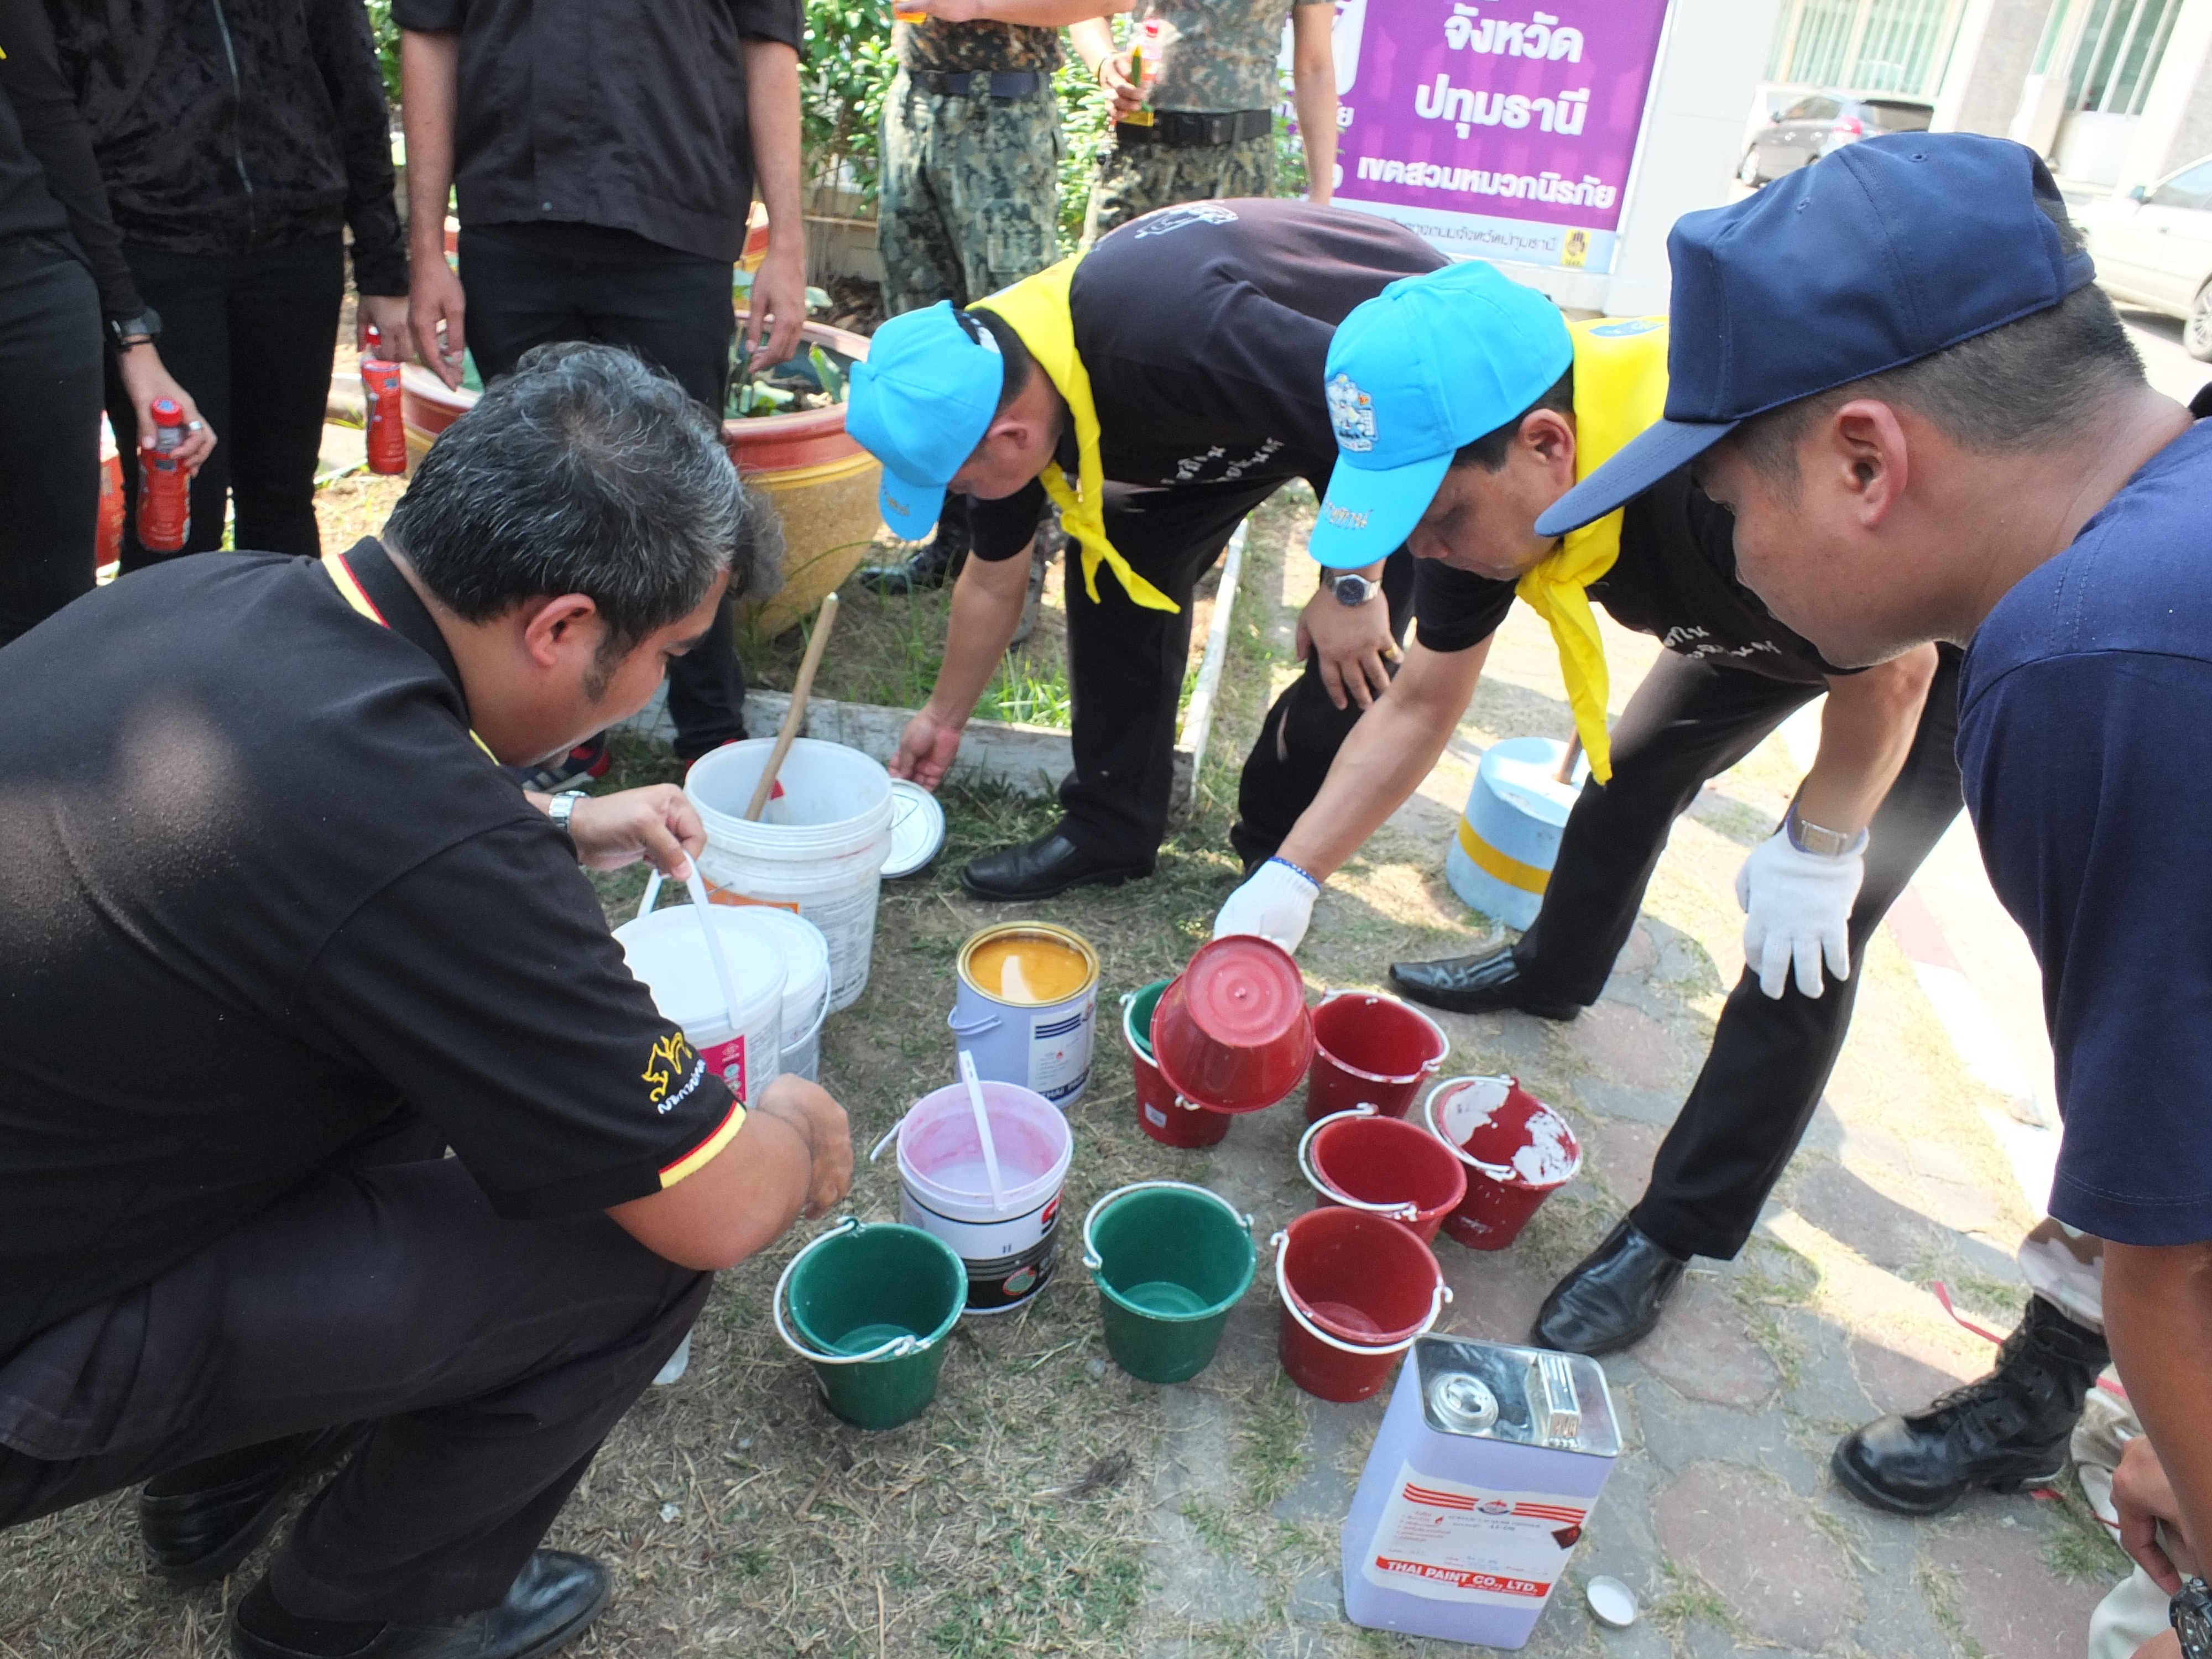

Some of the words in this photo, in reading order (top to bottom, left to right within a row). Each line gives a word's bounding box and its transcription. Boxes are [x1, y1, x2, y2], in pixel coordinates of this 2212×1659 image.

[1443, 2, 1584, 64] จังหวัด
[1414, 72, 1592, 140] ปทุมธานี
[1356, 156, 1618, 210] เขตสวมหมวกนิรภัย
[1386, 1559, 1422, 1574] THAI
[1424, 1567, 1470, 1582] PAINT
[1472, 1574, 1503, 1590] CO.,
[1506, 1579, 1538, 1594] LTD.
